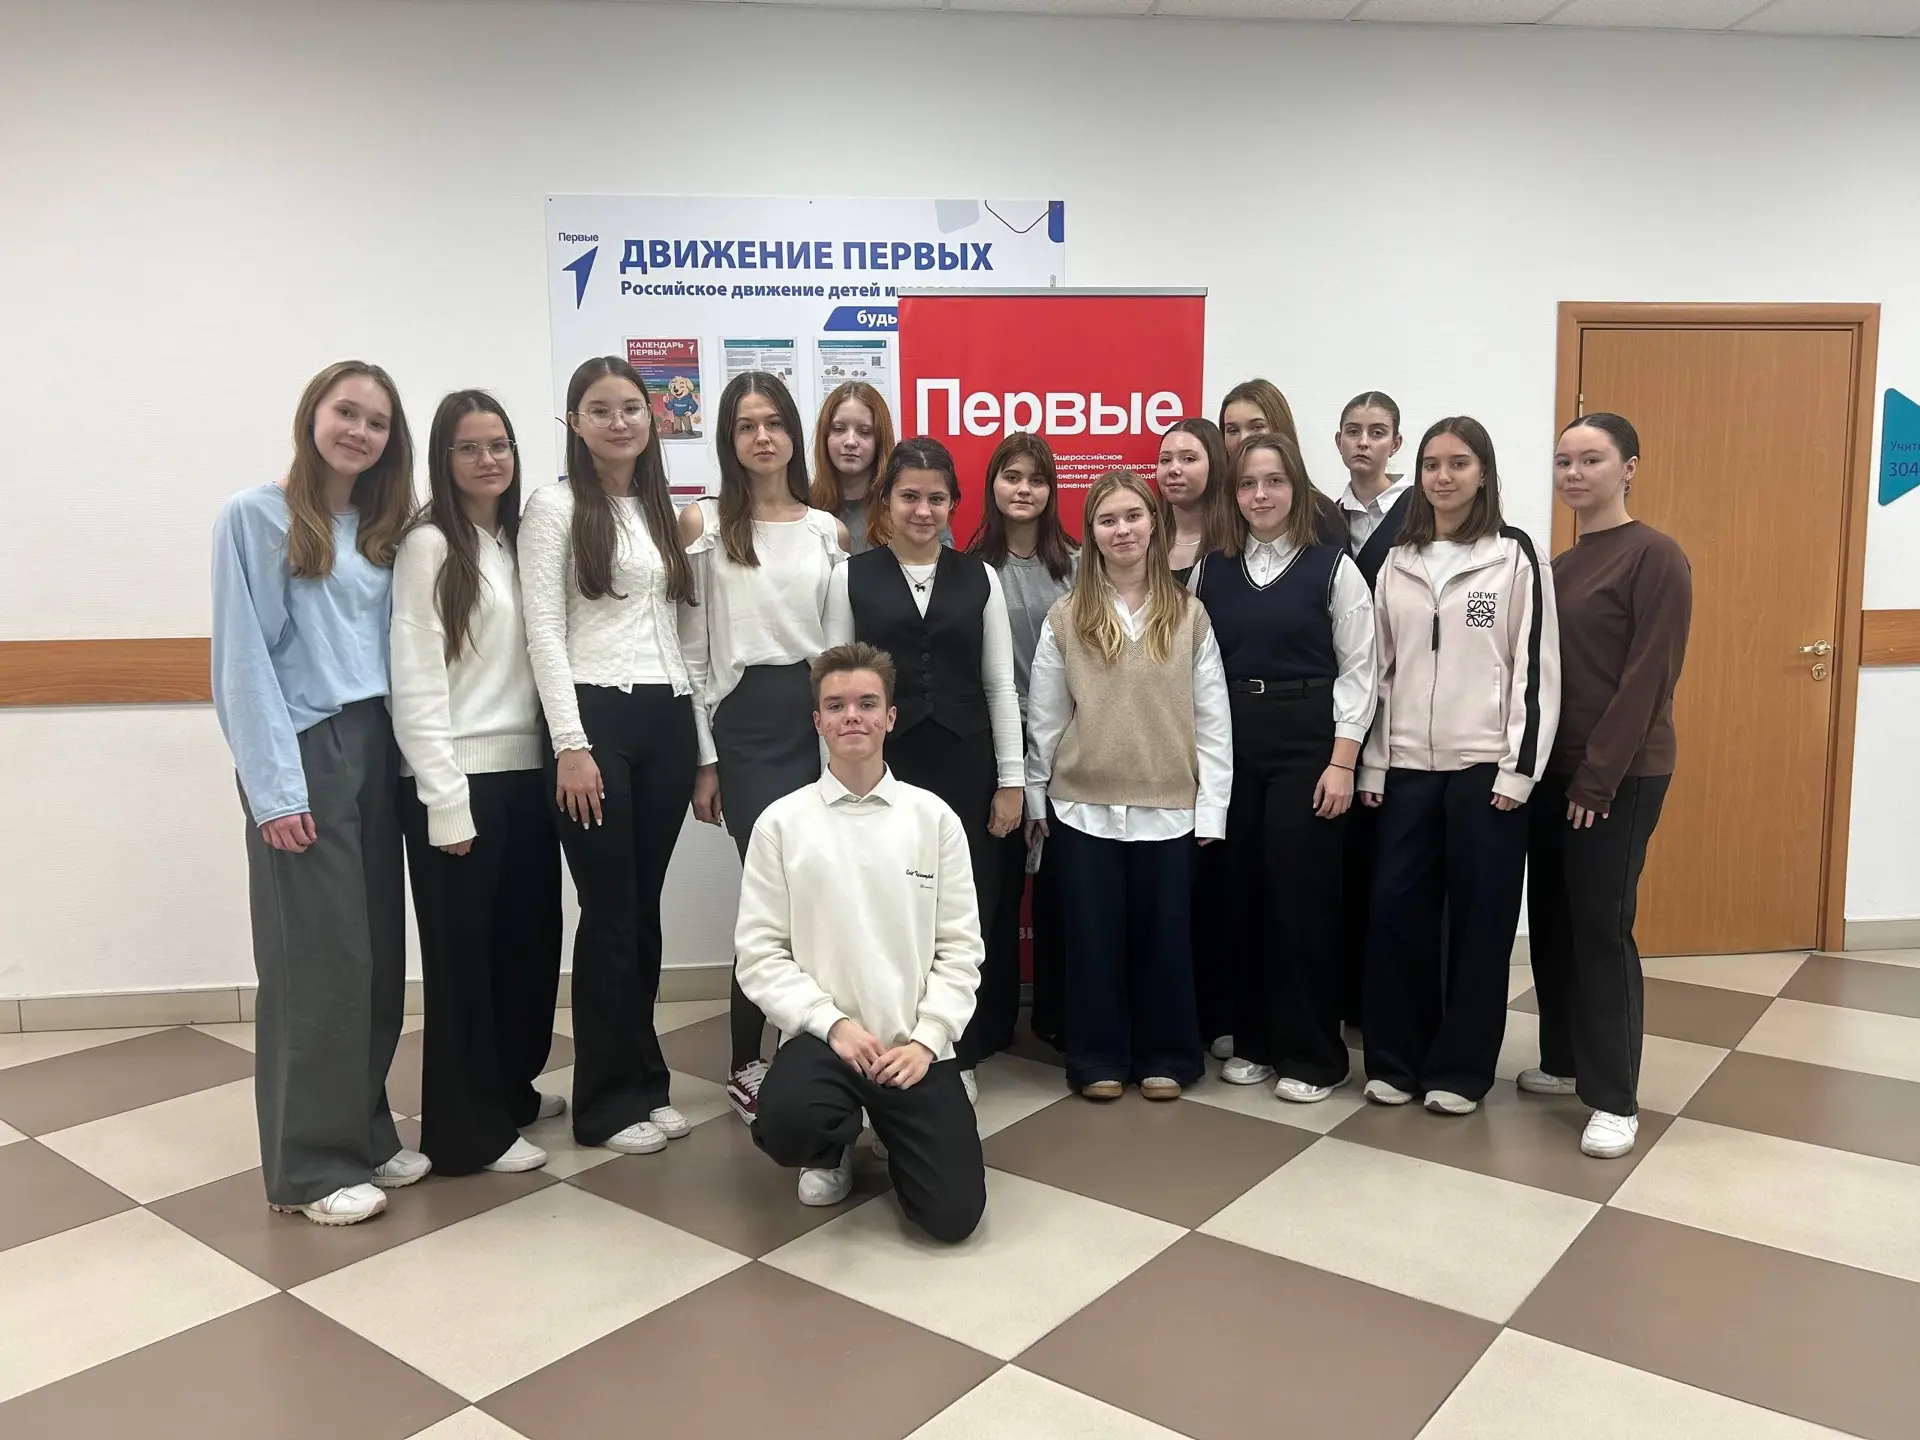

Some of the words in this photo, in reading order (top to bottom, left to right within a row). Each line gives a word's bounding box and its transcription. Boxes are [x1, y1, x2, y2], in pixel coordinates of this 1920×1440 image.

[558, 232, 599, 244] Первые
[619, 239, 834, 274] ДВИЖЕНИЕ
[842, 241, 994, 271] ПЕРВЫХ
[621, 281, 728, 296] Российское
[731, 284, 825, 299] движение
[828, 282, 880, 299] детей
[856, 309, 898, 328] будь
[629, 341, 684, 349] КАЛЕНДАРЬ
[916, 378, 1184, 440] Первые
[1052, 453, 1122, 461] бщероссийское
[1055, 463, 1157, 471] щественно-государств
[1888, 462, 1918, 477] 304
[1468, 591, 1498, 600] LOEWE
